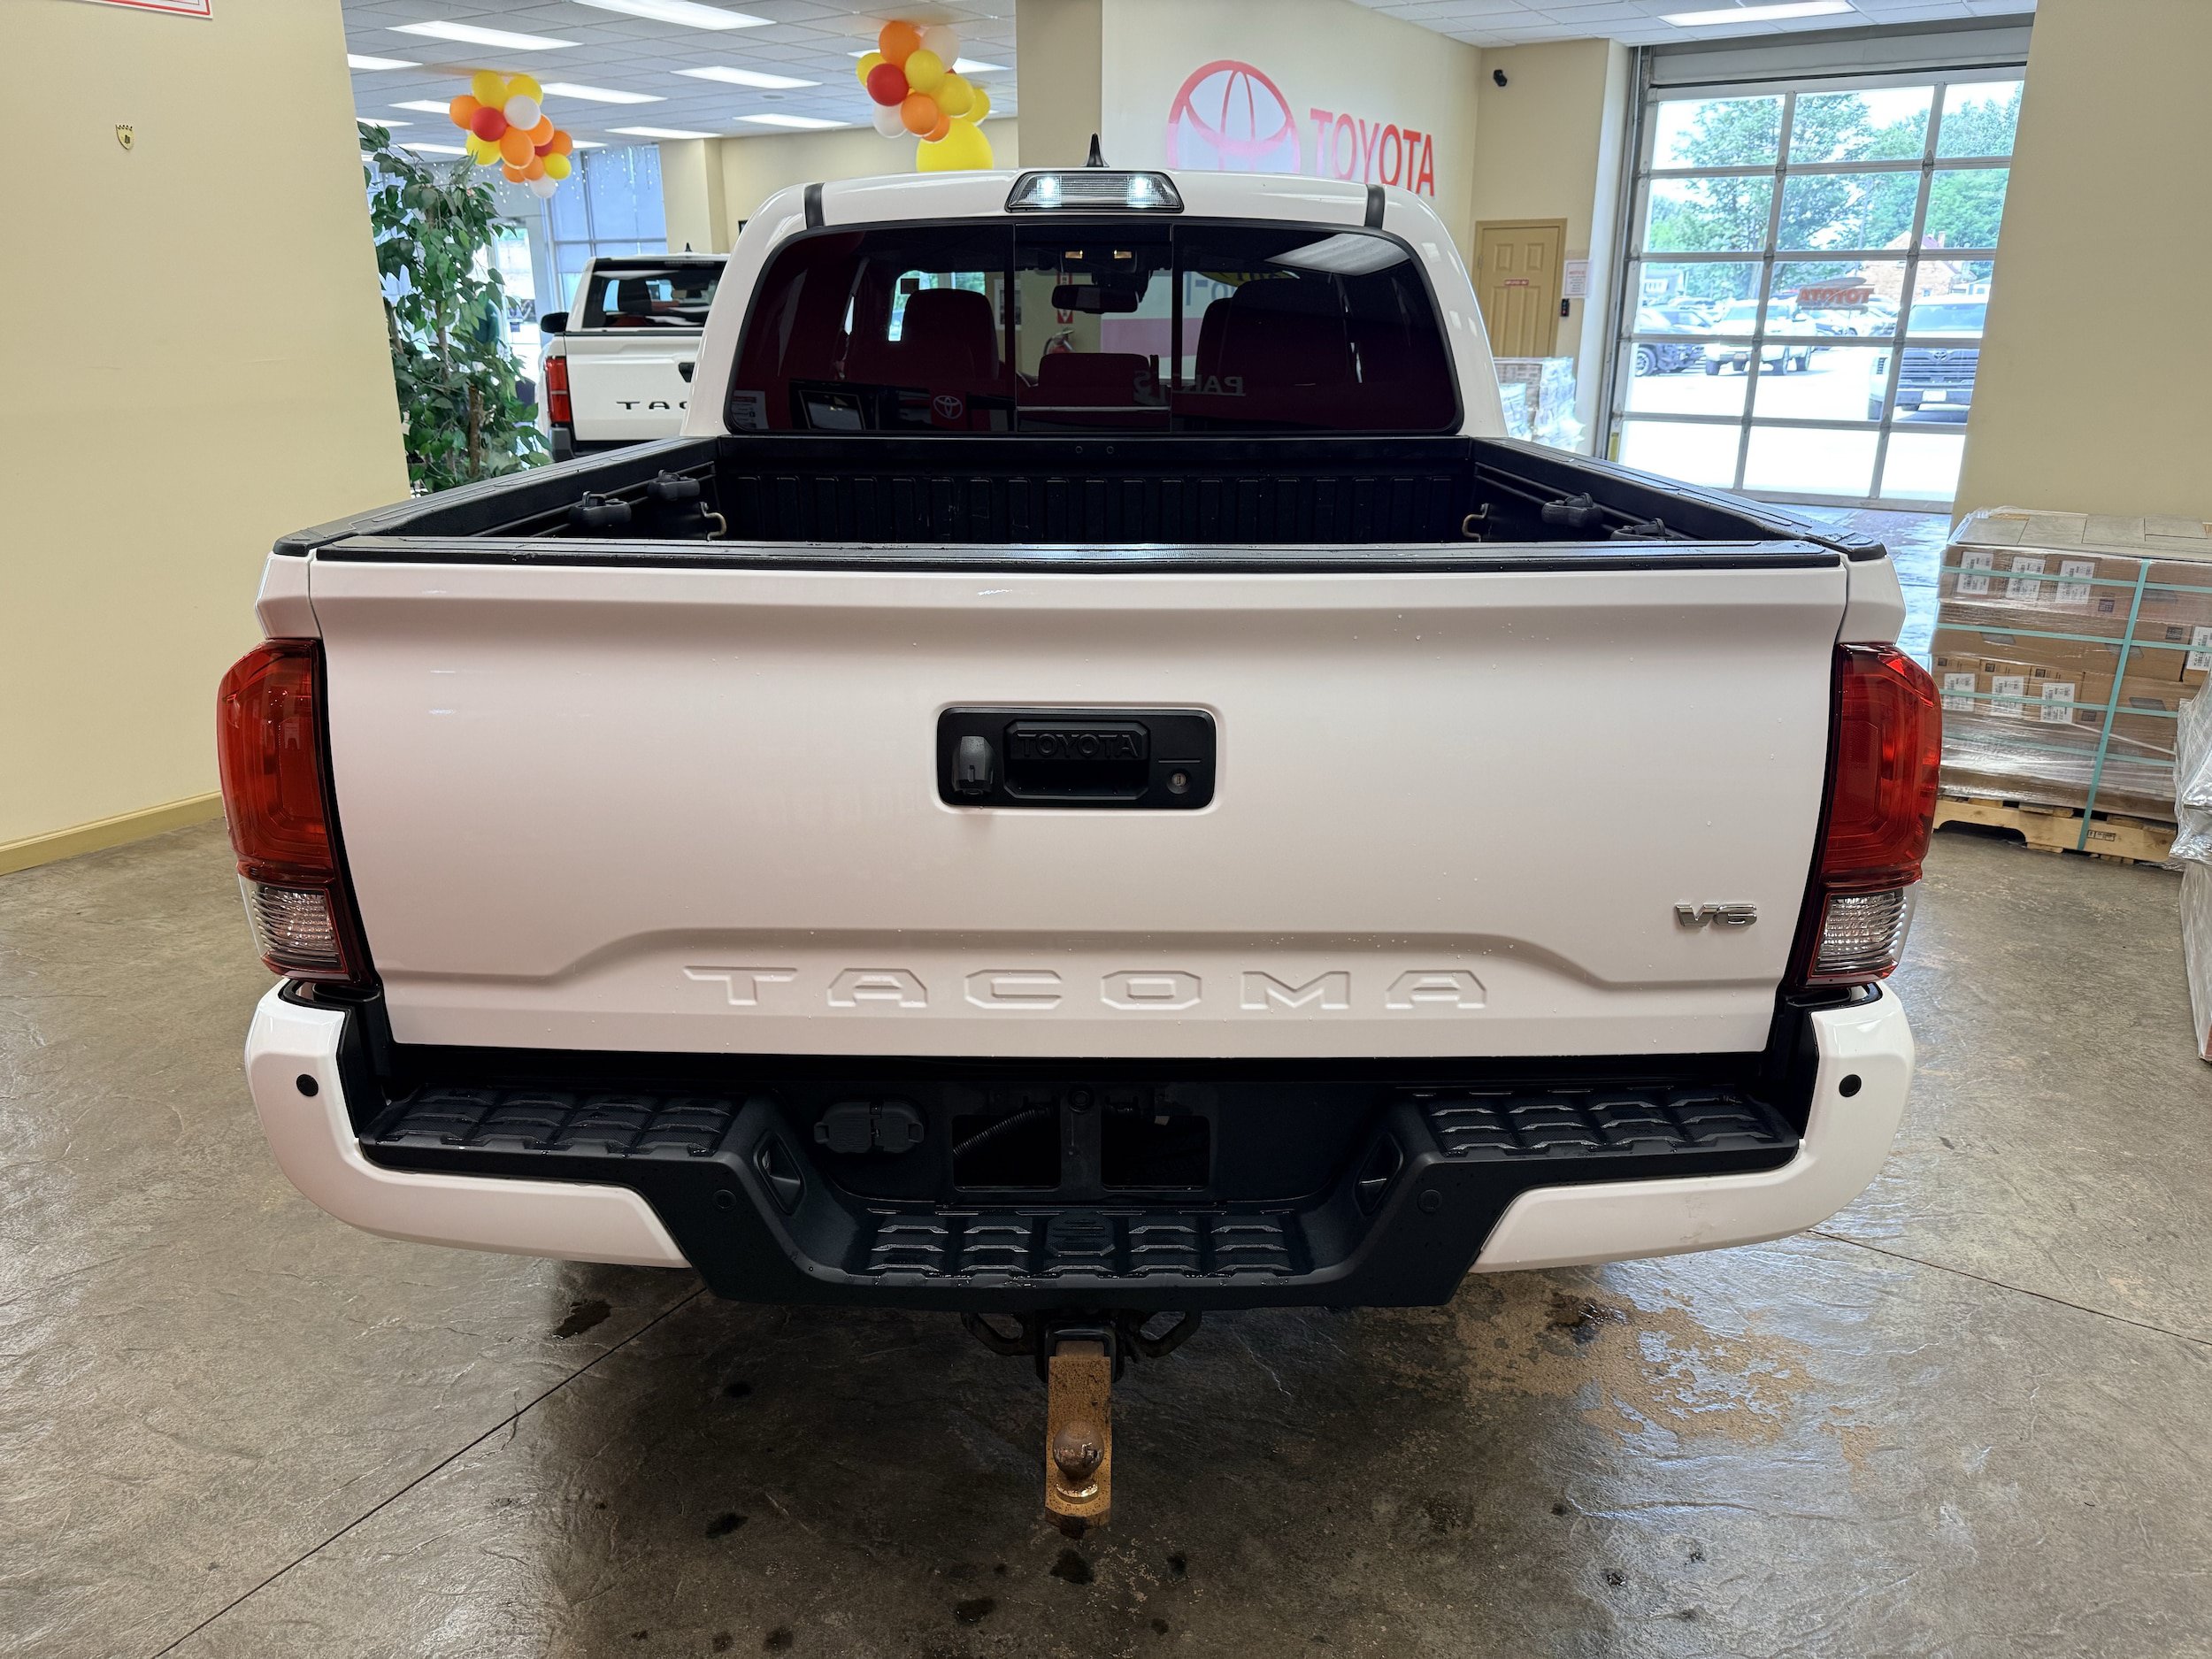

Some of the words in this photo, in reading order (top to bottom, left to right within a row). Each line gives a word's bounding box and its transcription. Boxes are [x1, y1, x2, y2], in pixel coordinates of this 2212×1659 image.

[1310, 108, 1434, 196] TOYOTA
[1018, 733, 1139, 757] TOYOTA
[1674, 902, 1757, 927] V6
[684, 966, 1486, 1010] TACOMA
